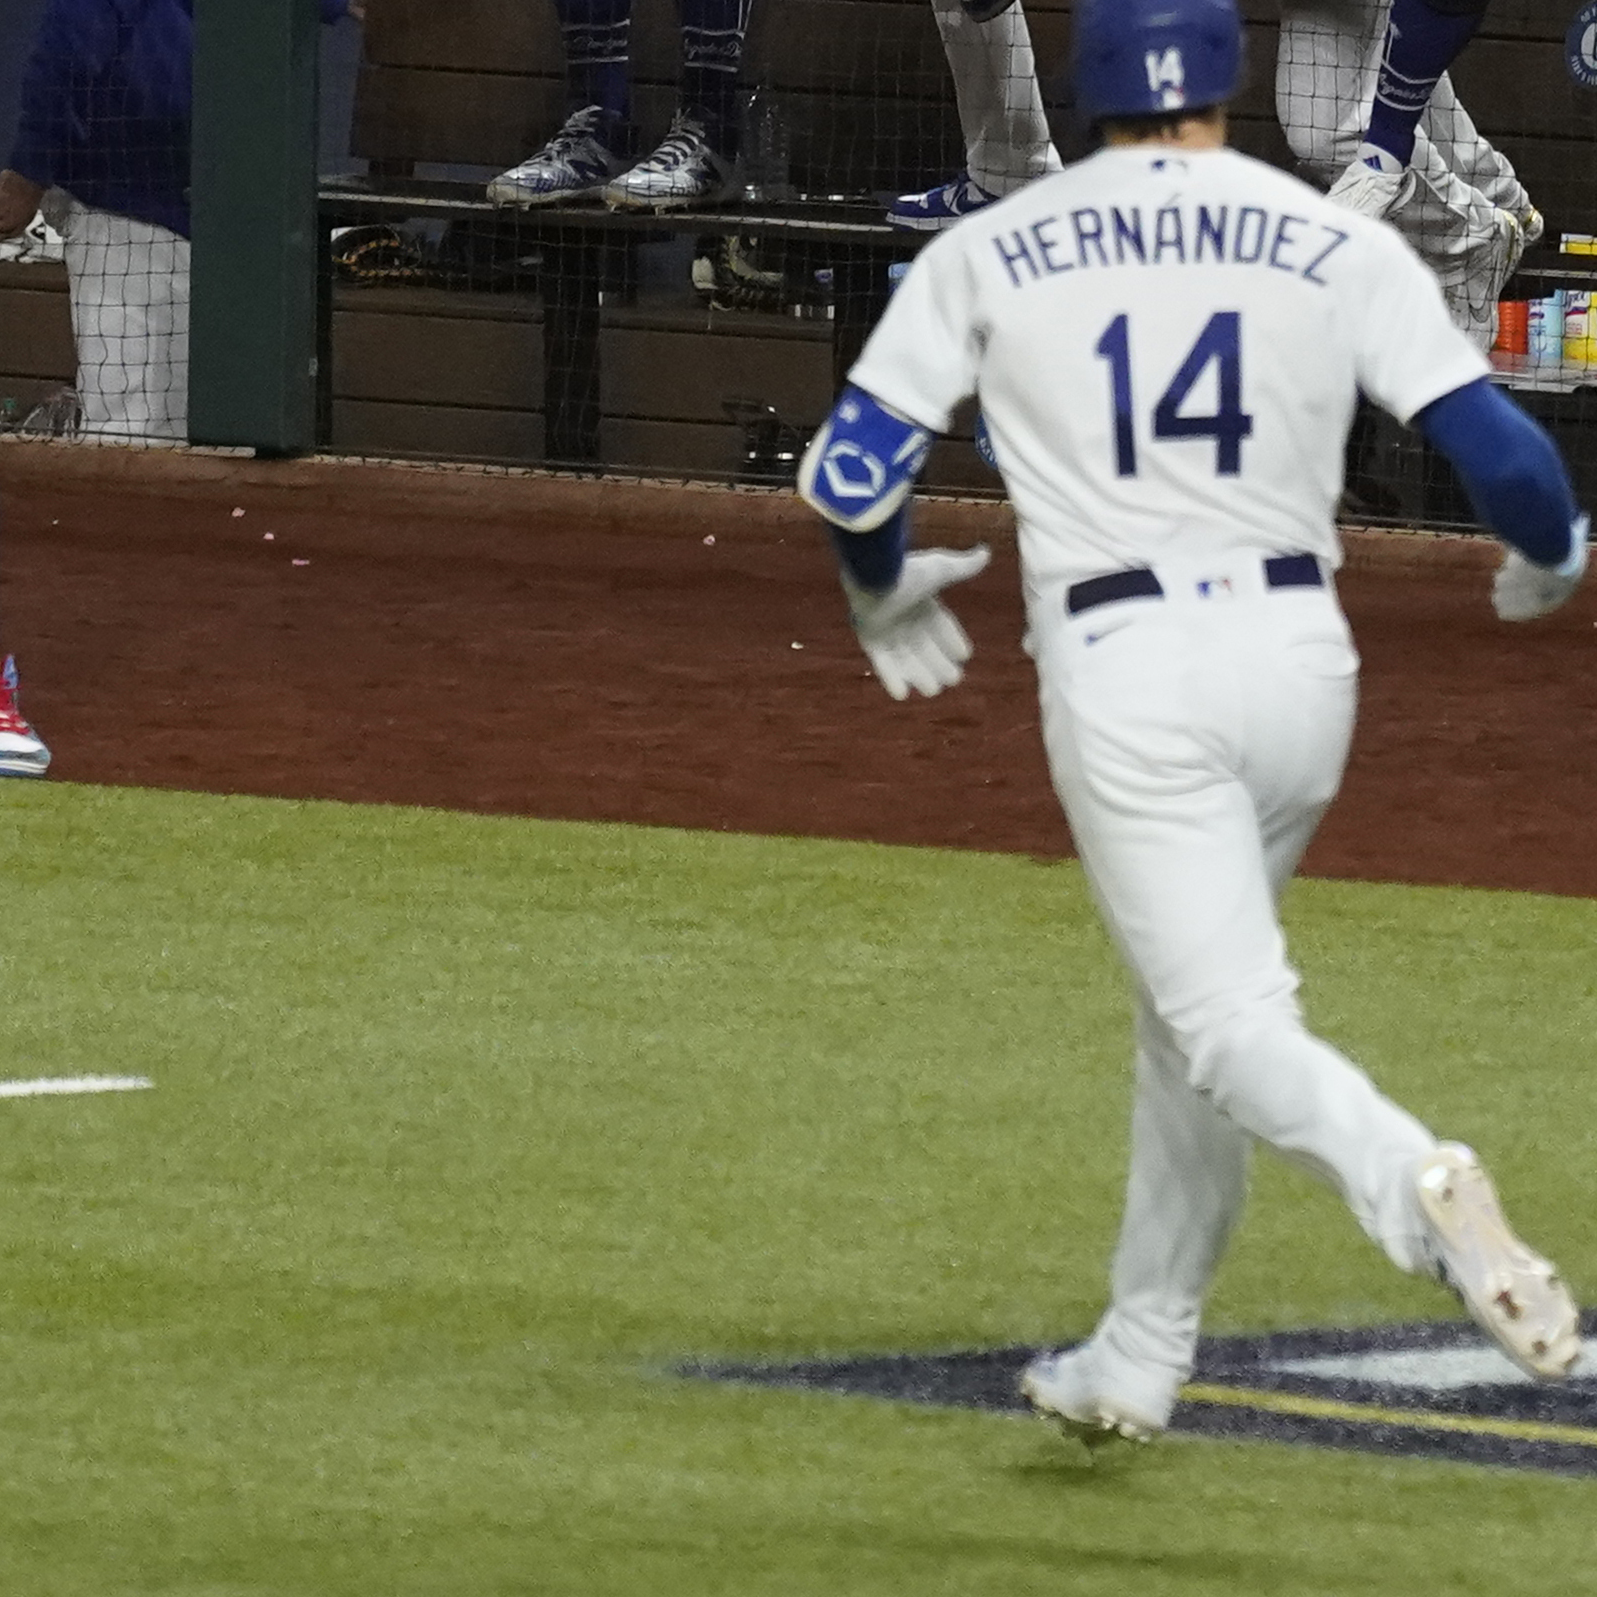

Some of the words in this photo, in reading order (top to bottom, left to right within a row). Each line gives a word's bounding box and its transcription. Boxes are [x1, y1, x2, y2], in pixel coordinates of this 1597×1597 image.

[1145, 48, 1184, 92] 14
[993, 192, 1354, 289] HERNÁNDEZ
[1093, 310, 1254, 480] 14
